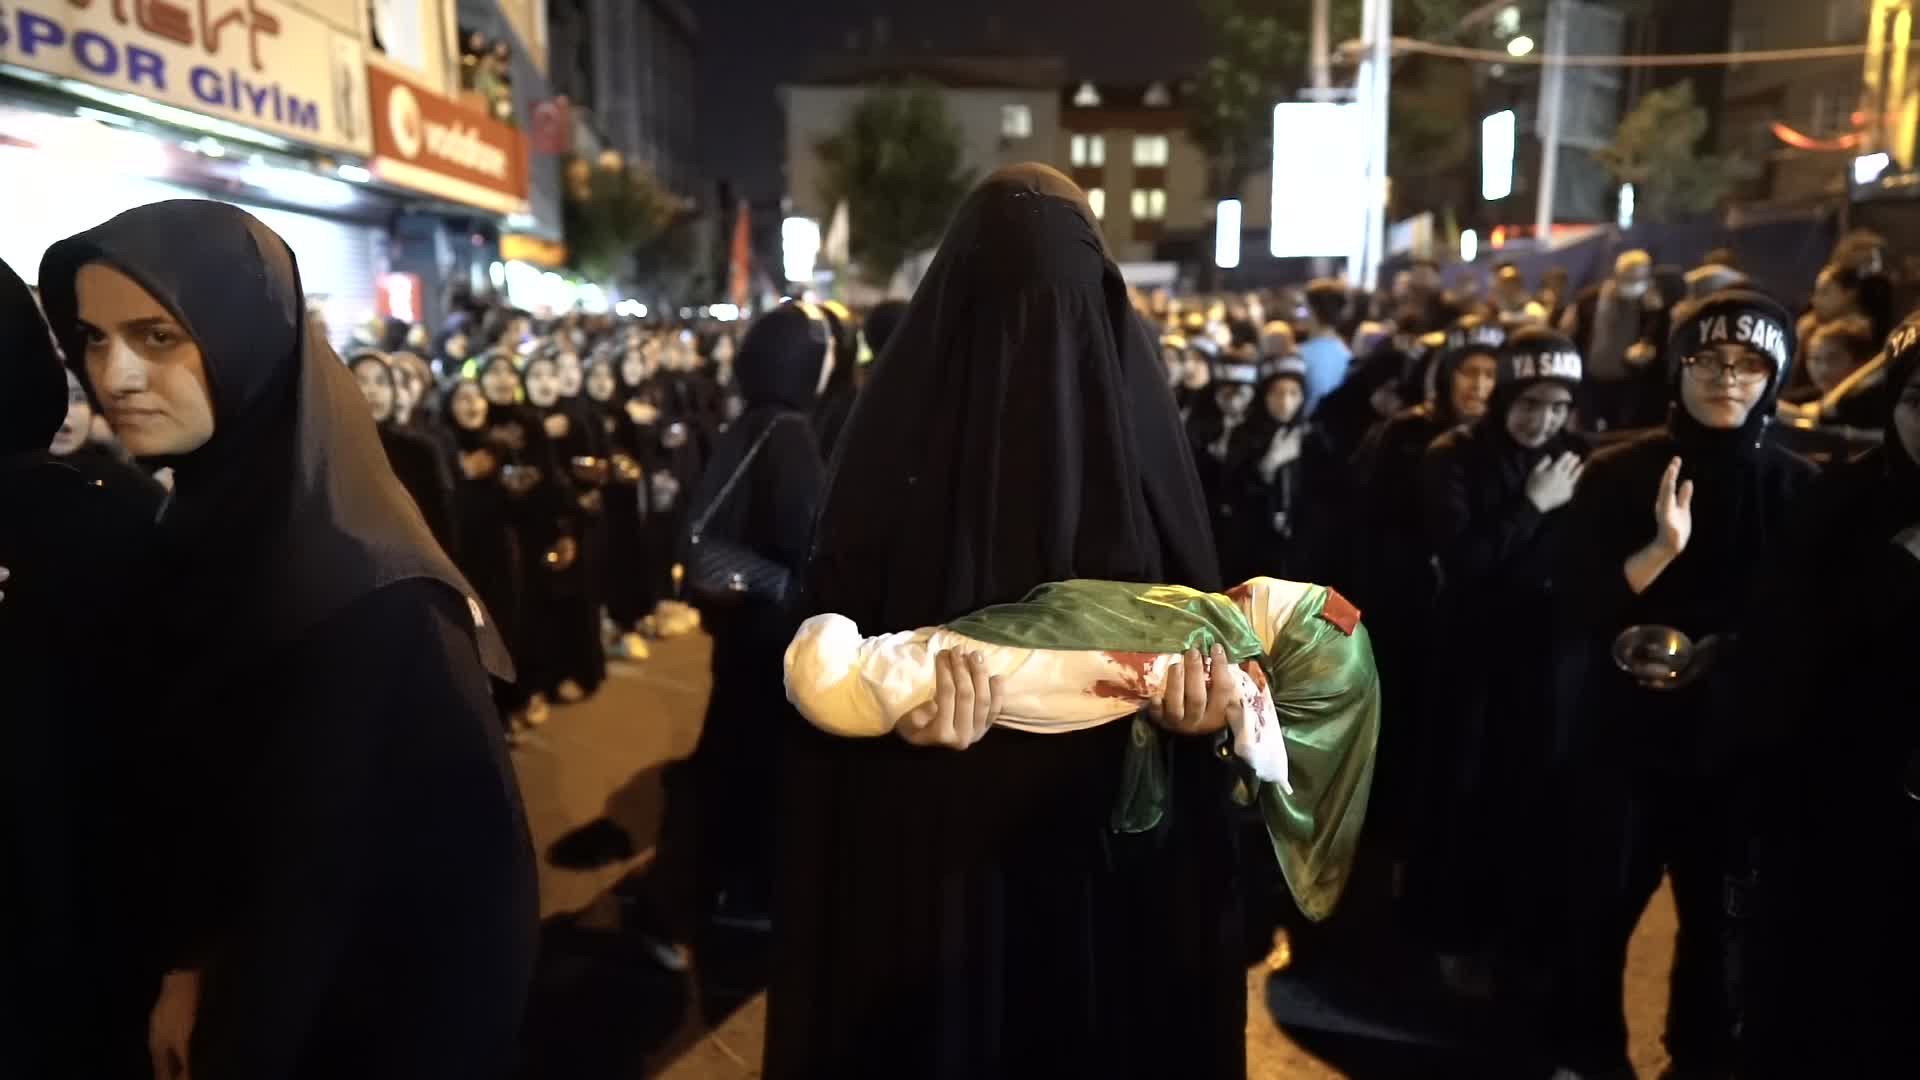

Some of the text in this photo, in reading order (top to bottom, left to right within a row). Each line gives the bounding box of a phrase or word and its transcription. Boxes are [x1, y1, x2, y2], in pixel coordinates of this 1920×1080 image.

[0, 8, 166, 90] POR
[68, 0, 280, 71] ert
[1700, 315, 1729, 344] YA
[1512, 353, 1536, 380] YA
